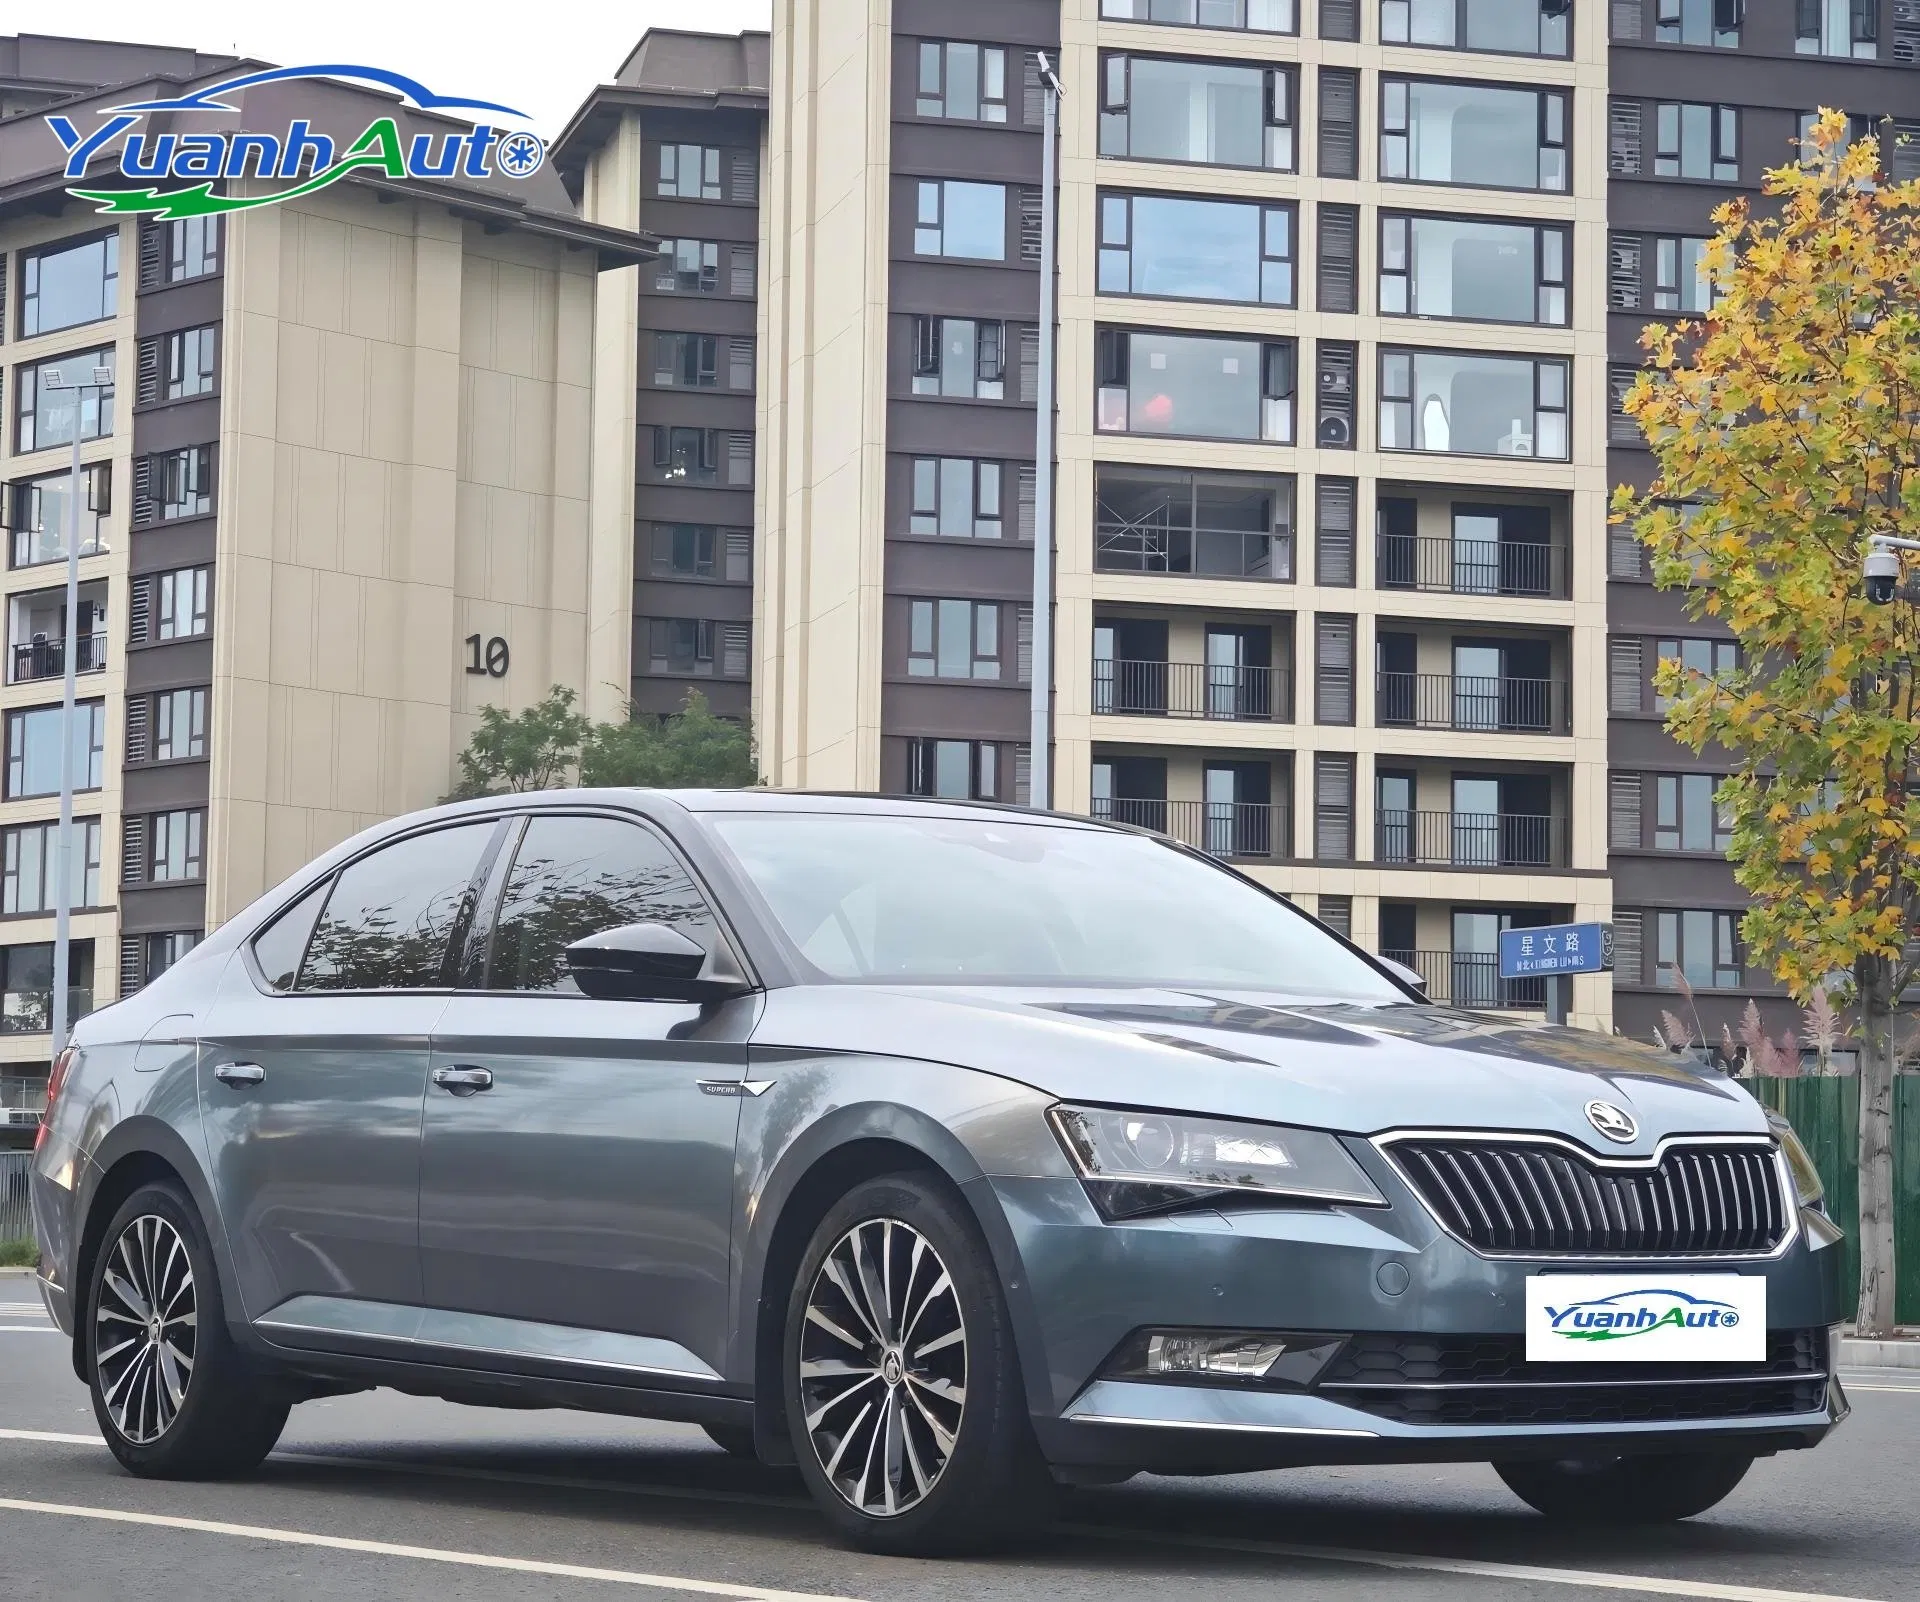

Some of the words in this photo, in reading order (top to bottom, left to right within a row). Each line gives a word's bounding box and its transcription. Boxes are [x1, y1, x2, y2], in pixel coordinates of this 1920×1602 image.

[465, 633, 510, 678] 10
[1521, 931, 1580, 956] 星文路
